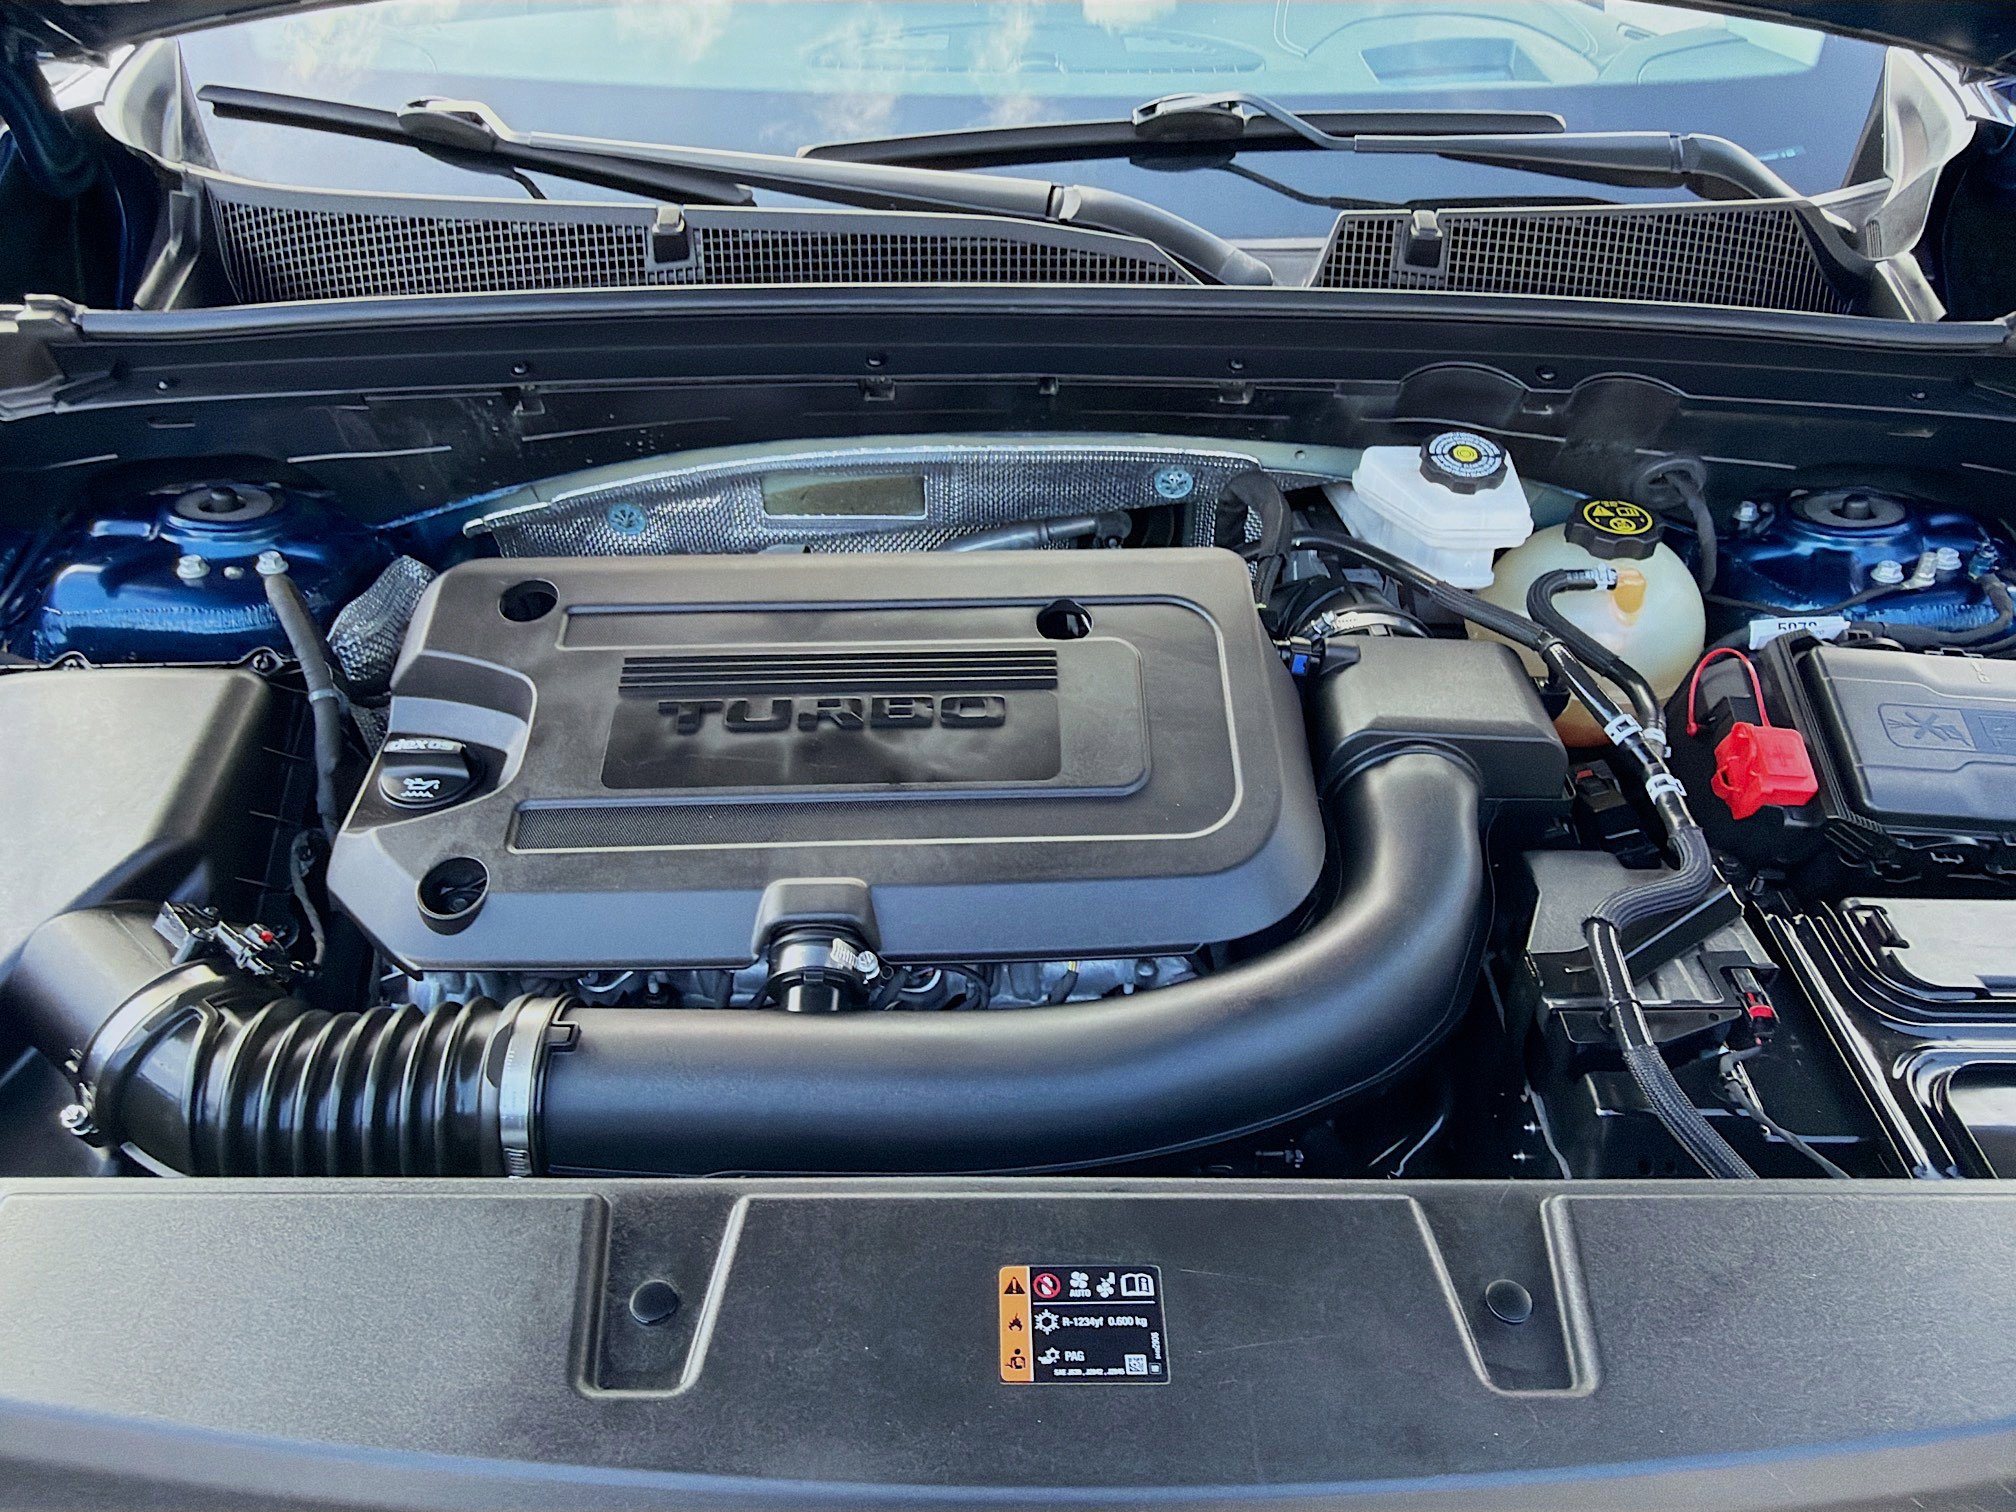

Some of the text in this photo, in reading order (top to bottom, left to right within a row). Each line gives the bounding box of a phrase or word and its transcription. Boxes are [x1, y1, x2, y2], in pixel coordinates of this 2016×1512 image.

[658, 694, 1006, 735] TURBO
[389, 738, 454, 751] dexos
[1069, 1288, 1091, 1298] AUTO
[1062, 1316, 1104, 1328] R-1234yf
[1136, 1316, 1148, 1328] kg
[1064, 1350, 1085, 1362] PAG
